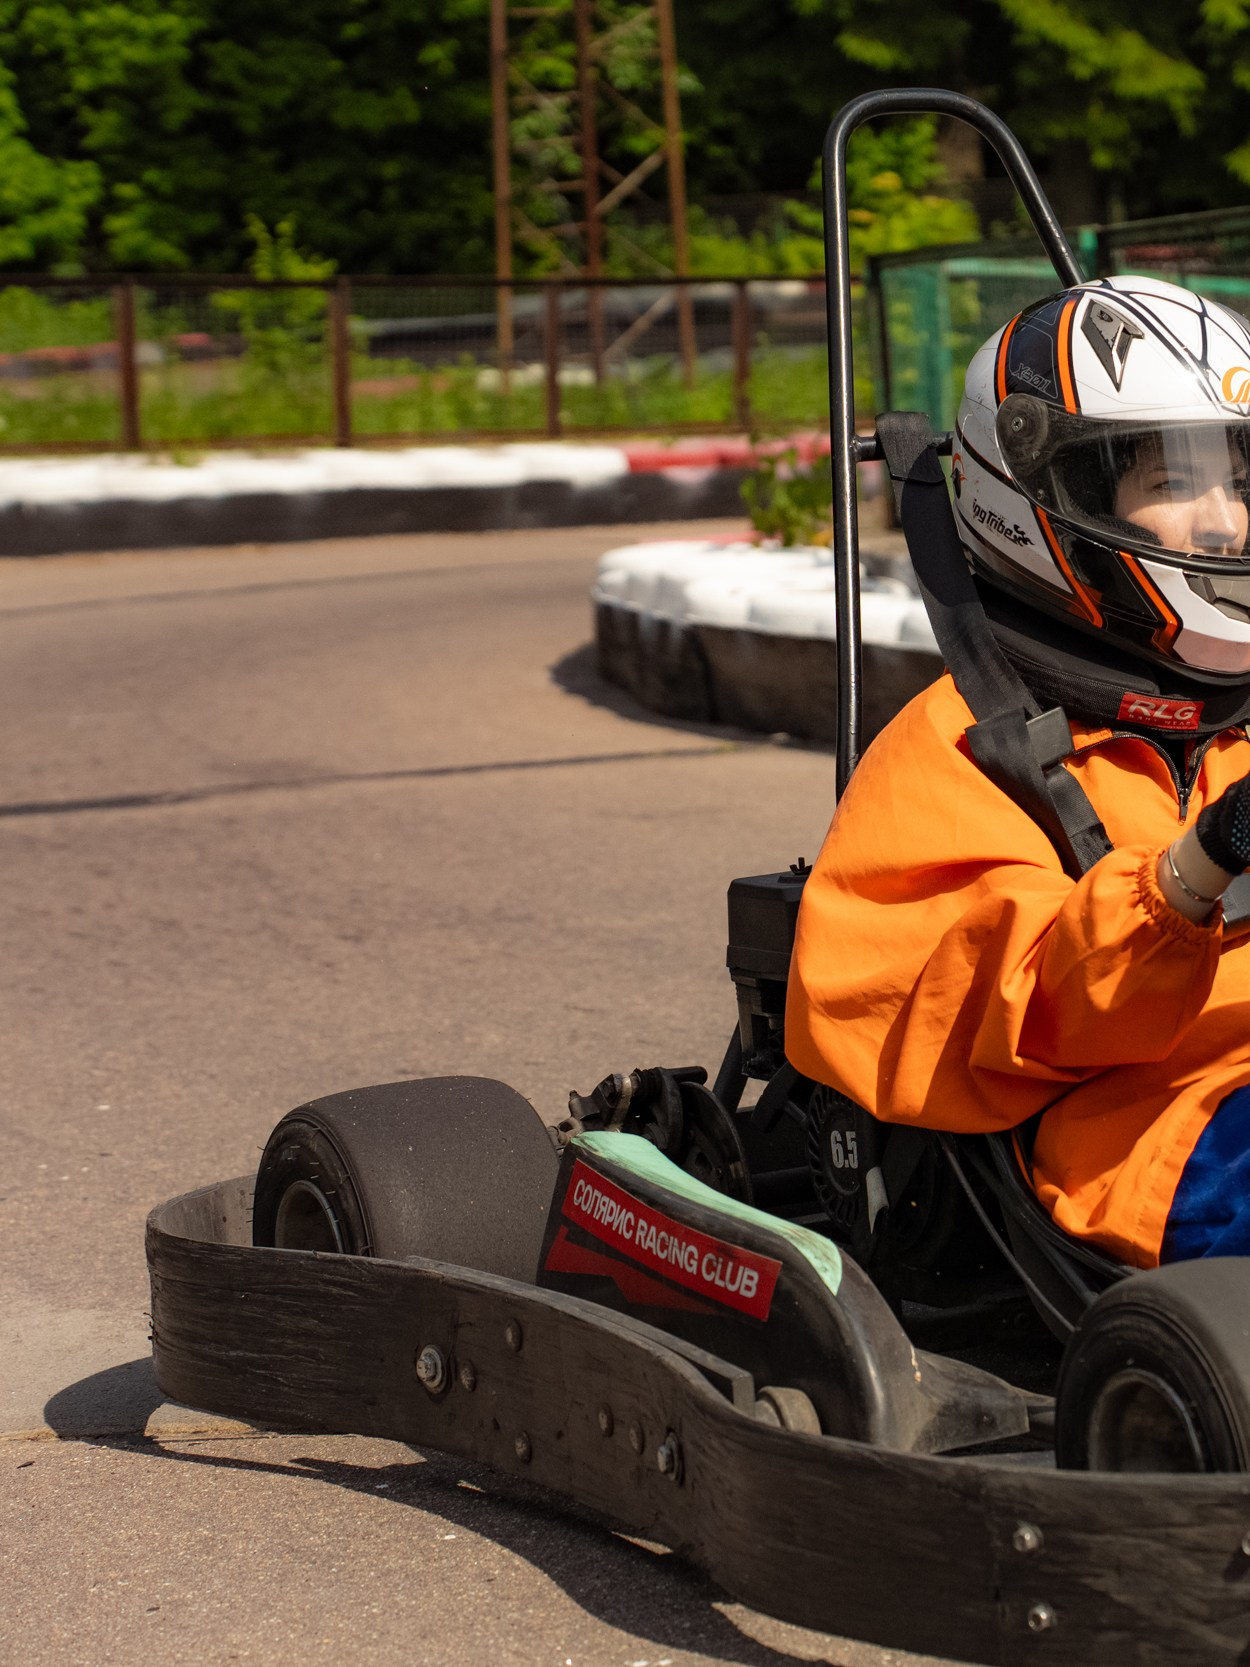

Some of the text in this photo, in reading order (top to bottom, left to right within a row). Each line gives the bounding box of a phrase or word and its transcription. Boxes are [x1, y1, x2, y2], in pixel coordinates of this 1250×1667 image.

[1127, 699, 1197, 720] RLG
[830, 1129, 859, 1169] 6.5
[635, 1218, 699, 1275] RACING
[701, 1253, 760, 1299] CLUB
